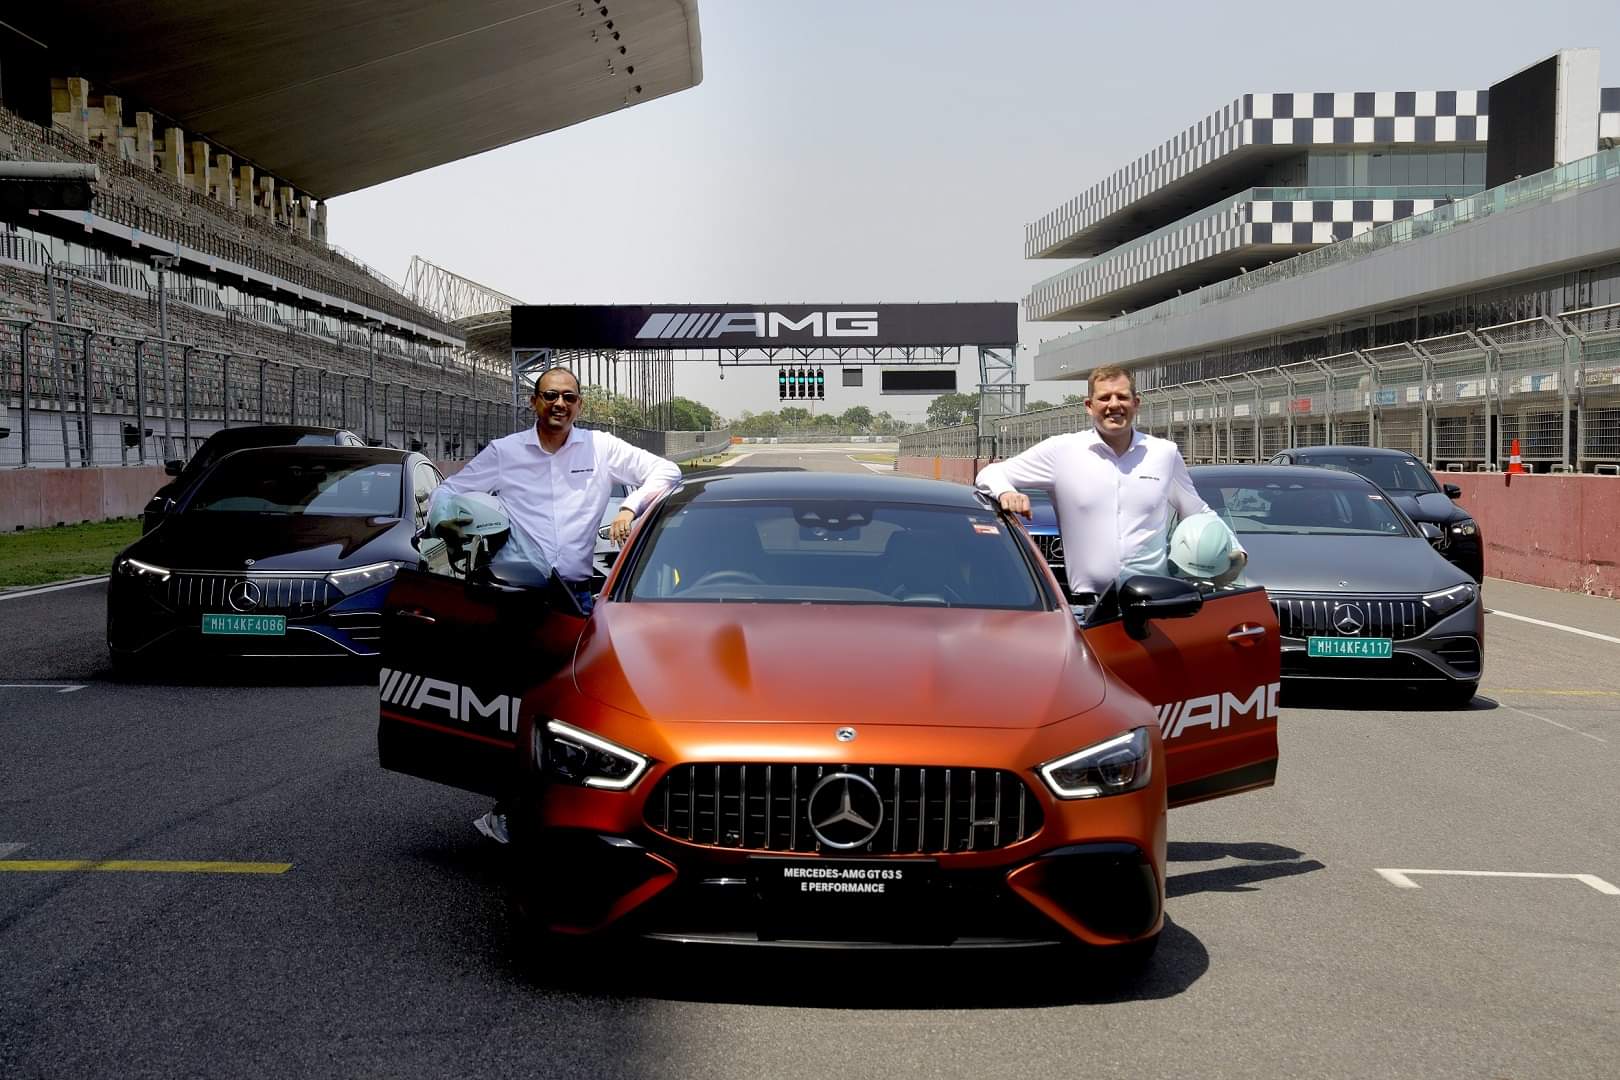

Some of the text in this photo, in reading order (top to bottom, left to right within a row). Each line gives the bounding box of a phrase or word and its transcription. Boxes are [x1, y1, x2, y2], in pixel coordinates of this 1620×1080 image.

[707, 311, 878, 339] AMG
[211, 618, 283, 632] MH14KF4086
[1317, 641, 1390, 655] MH14KF4117
[410, 677, 521, 733] AM
[784, 867, 903, 879] MERCEDES-AMG GT 63 S
[801, 882, 885, 893] E PERFORMANCE
